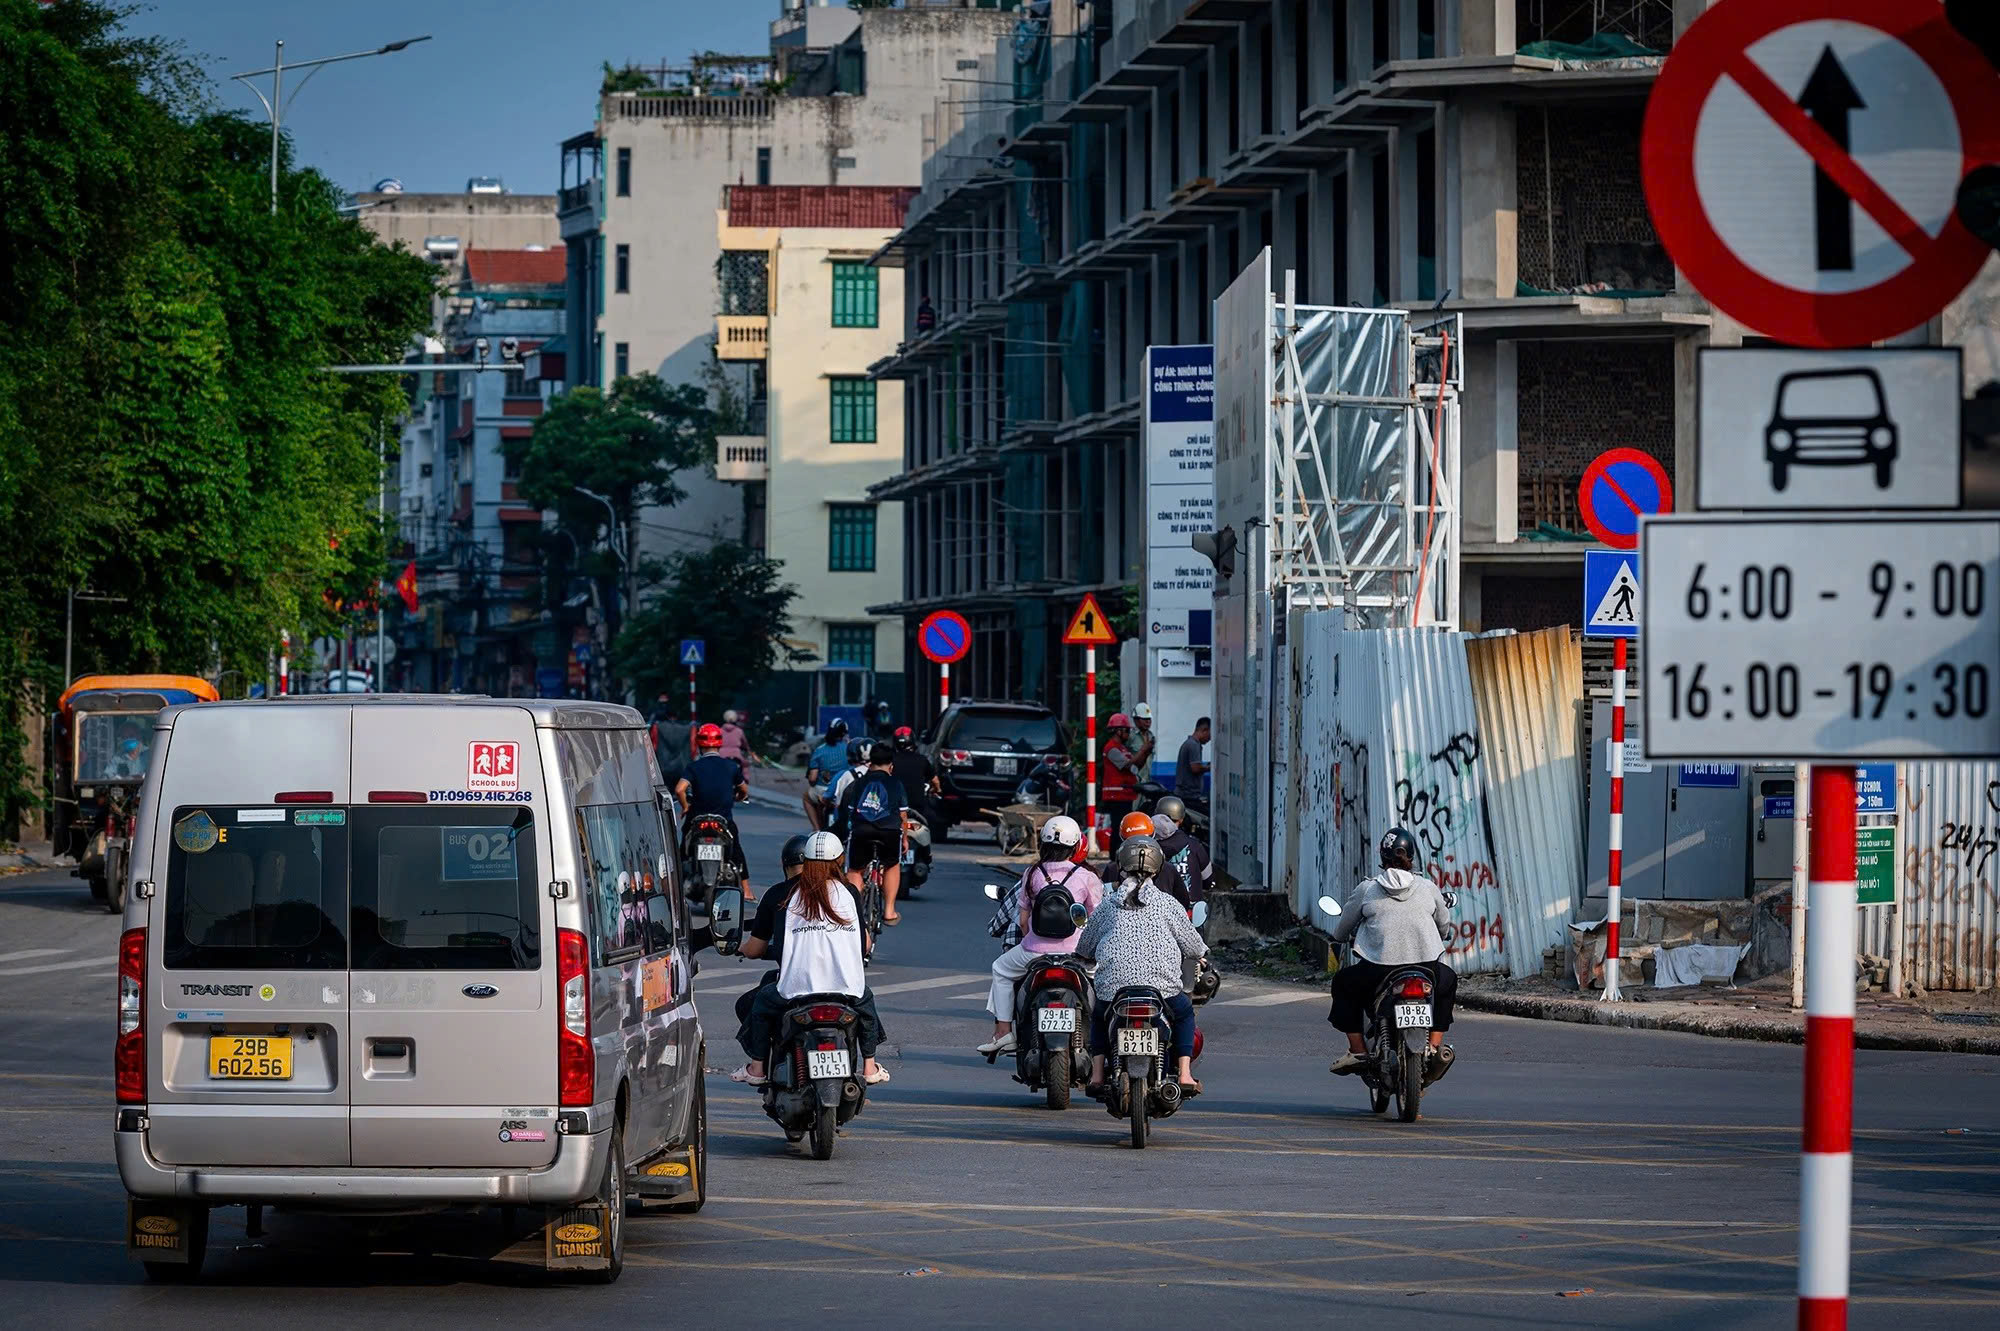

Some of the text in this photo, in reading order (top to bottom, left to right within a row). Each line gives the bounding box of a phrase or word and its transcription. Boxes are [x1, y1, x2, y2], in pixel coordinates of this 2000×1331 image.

[1154, 380, 1172, 392] CÔNG
[1169, 448, 1184, 457] CÔNG
[1186, 449, 1191, 457] TY
[1157, 511, 1172, 520] CÔNG
[1174, 511, 1180, 519] TY
[1153, 581, 1168, 590] CÔNG
[1169, 581, 1176, 589] TY
[1686, 563, 1793, 620] 6:00
[1869, 561, 1985, 620] 9:00
[1863, 781, 1881, 792] SCHOOL
[1867, 795, 1883, 807] 150m
[218, 828, 227, 843] E
[449, 833, 511, 861] BUS 02
[180, 984, 253, 997] TRANSIT
[1044, 1009, 1069, 1019] 29-AE
[1401, 1006, 1426, 1016] 18-B2
[1041, 1020, 1073, 1031] 672.23
[1398, 1015, 1431, 1027] 792.69
[233, 1039, 268, 1056] 29B
[1123, 1041, 1153, 1053] 8216
[816, 1052, 843, 1064] 19-L1
[218, 1058, 282, 1076] 602.56
[812, 1064, 847, 1077] 314.51
[500, 1120, 528, 1130] ABS
[136, 1234, 179, 1249] TRANSIT
[555, 1243, 602, 1256] TRANSIT
